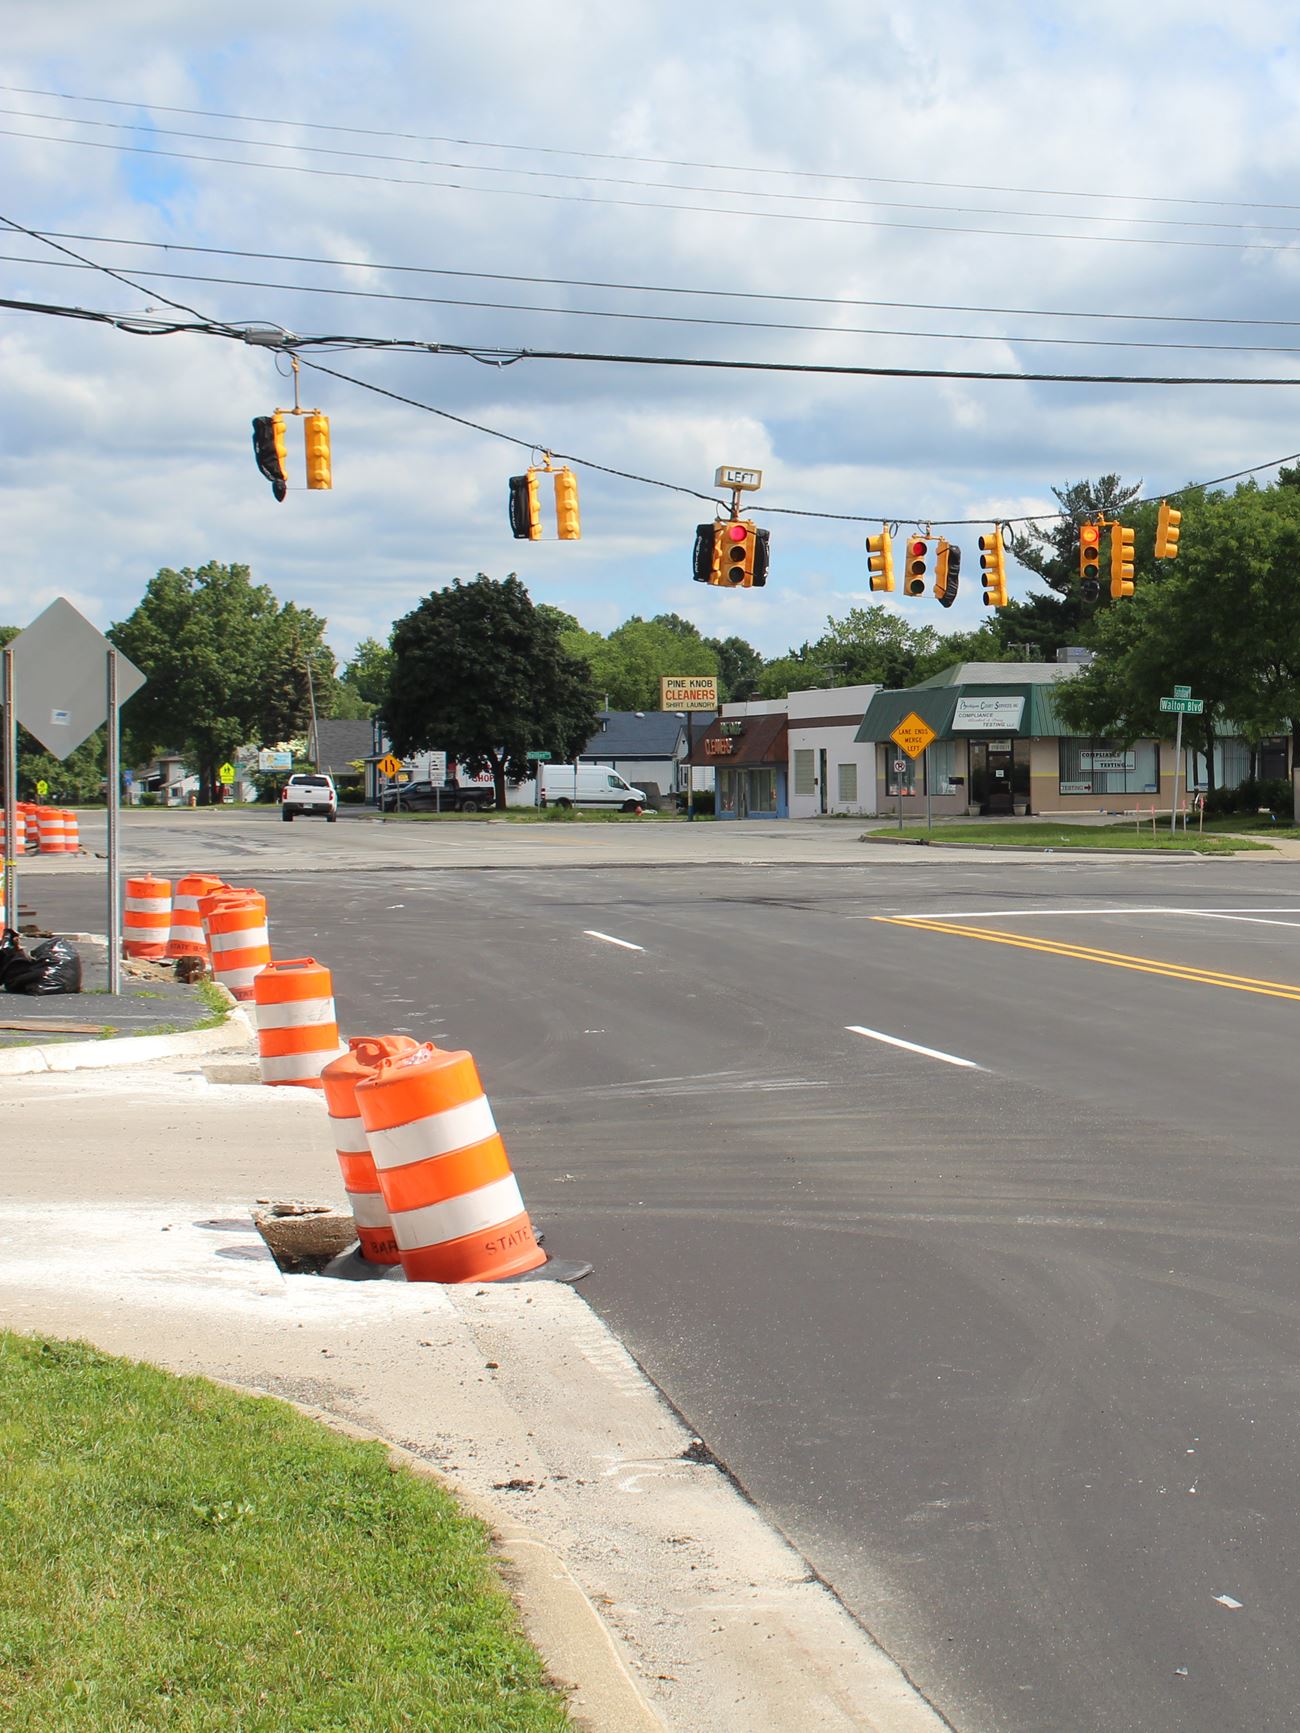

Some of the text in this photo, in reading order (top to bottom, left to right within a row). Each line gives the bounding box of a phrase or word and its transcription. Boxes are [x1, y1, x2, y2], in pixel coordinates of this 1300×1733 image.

[726, 471, 754, 483] LEFT
[667, 680, 713, 688] PINE KNOB
[665, 689, 715, 700] CLEANERS
[1161, 700, 1202, 712] Walton Blvd
[485, 1226, 531, 1256] STATE
